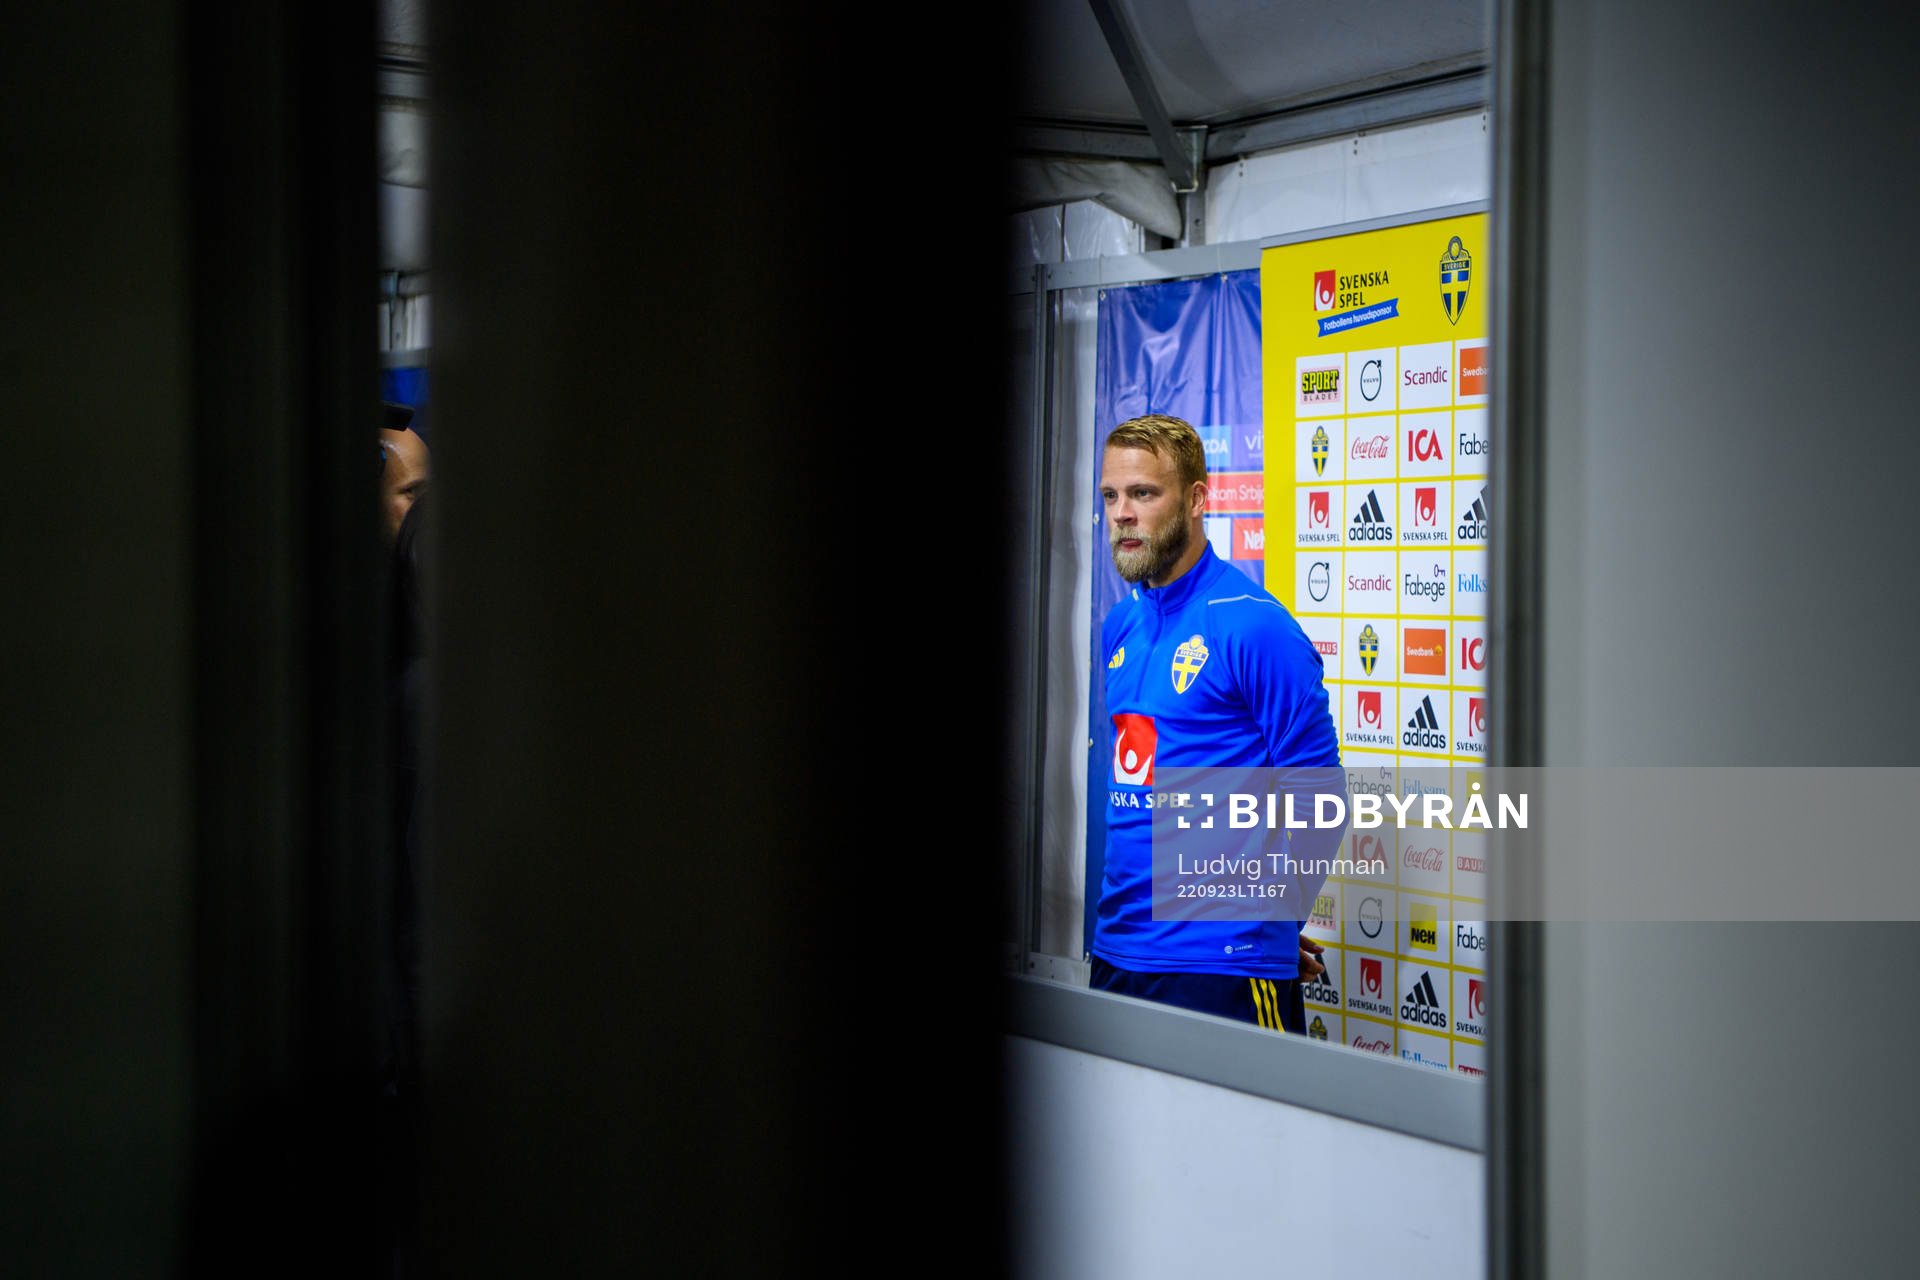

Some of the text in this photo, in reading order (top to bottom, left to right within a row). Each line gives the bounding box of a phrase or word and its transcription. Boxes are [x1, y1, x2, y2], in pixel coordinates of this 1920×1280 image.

[1339, 270, 1390, 291] SVENSKA
[1339, 292, 1366, 308] SPEL
[1323, 315, 1353, 331] Fotbollens
[1301, 369, 1340, 394] SPORT
[1404, 366, 1448, 387] Scandic
[1303, 393, 1338, 402] BLADET
[1408, 428, 1443, 462] ICA
[1298, 531, 1340, 543] SVENSKA SPEL
[1348, 522, 1393, 541] adidas
[1402, 531, 1448, 542] SVENSKA SPEL
[1348, 574, 1392, 592] Scandic
[1404, 574, 1446, 602] Fabege
[1313, 641, 1338, 655] HAUS
[1406, 646, 1434, 657] Swedbank
[1346, 732, 1395, 745] SVENSKA SPEL
[1402, 729, 1446, 749] adidas
[1347, 773, 1392, 803] Fabege
[1351, 834, 1389, 869] ICA
[1348, 998, 1393, 1016] SVENSKA SPEL
[1400, 1003, 1447, 1028] adidas
